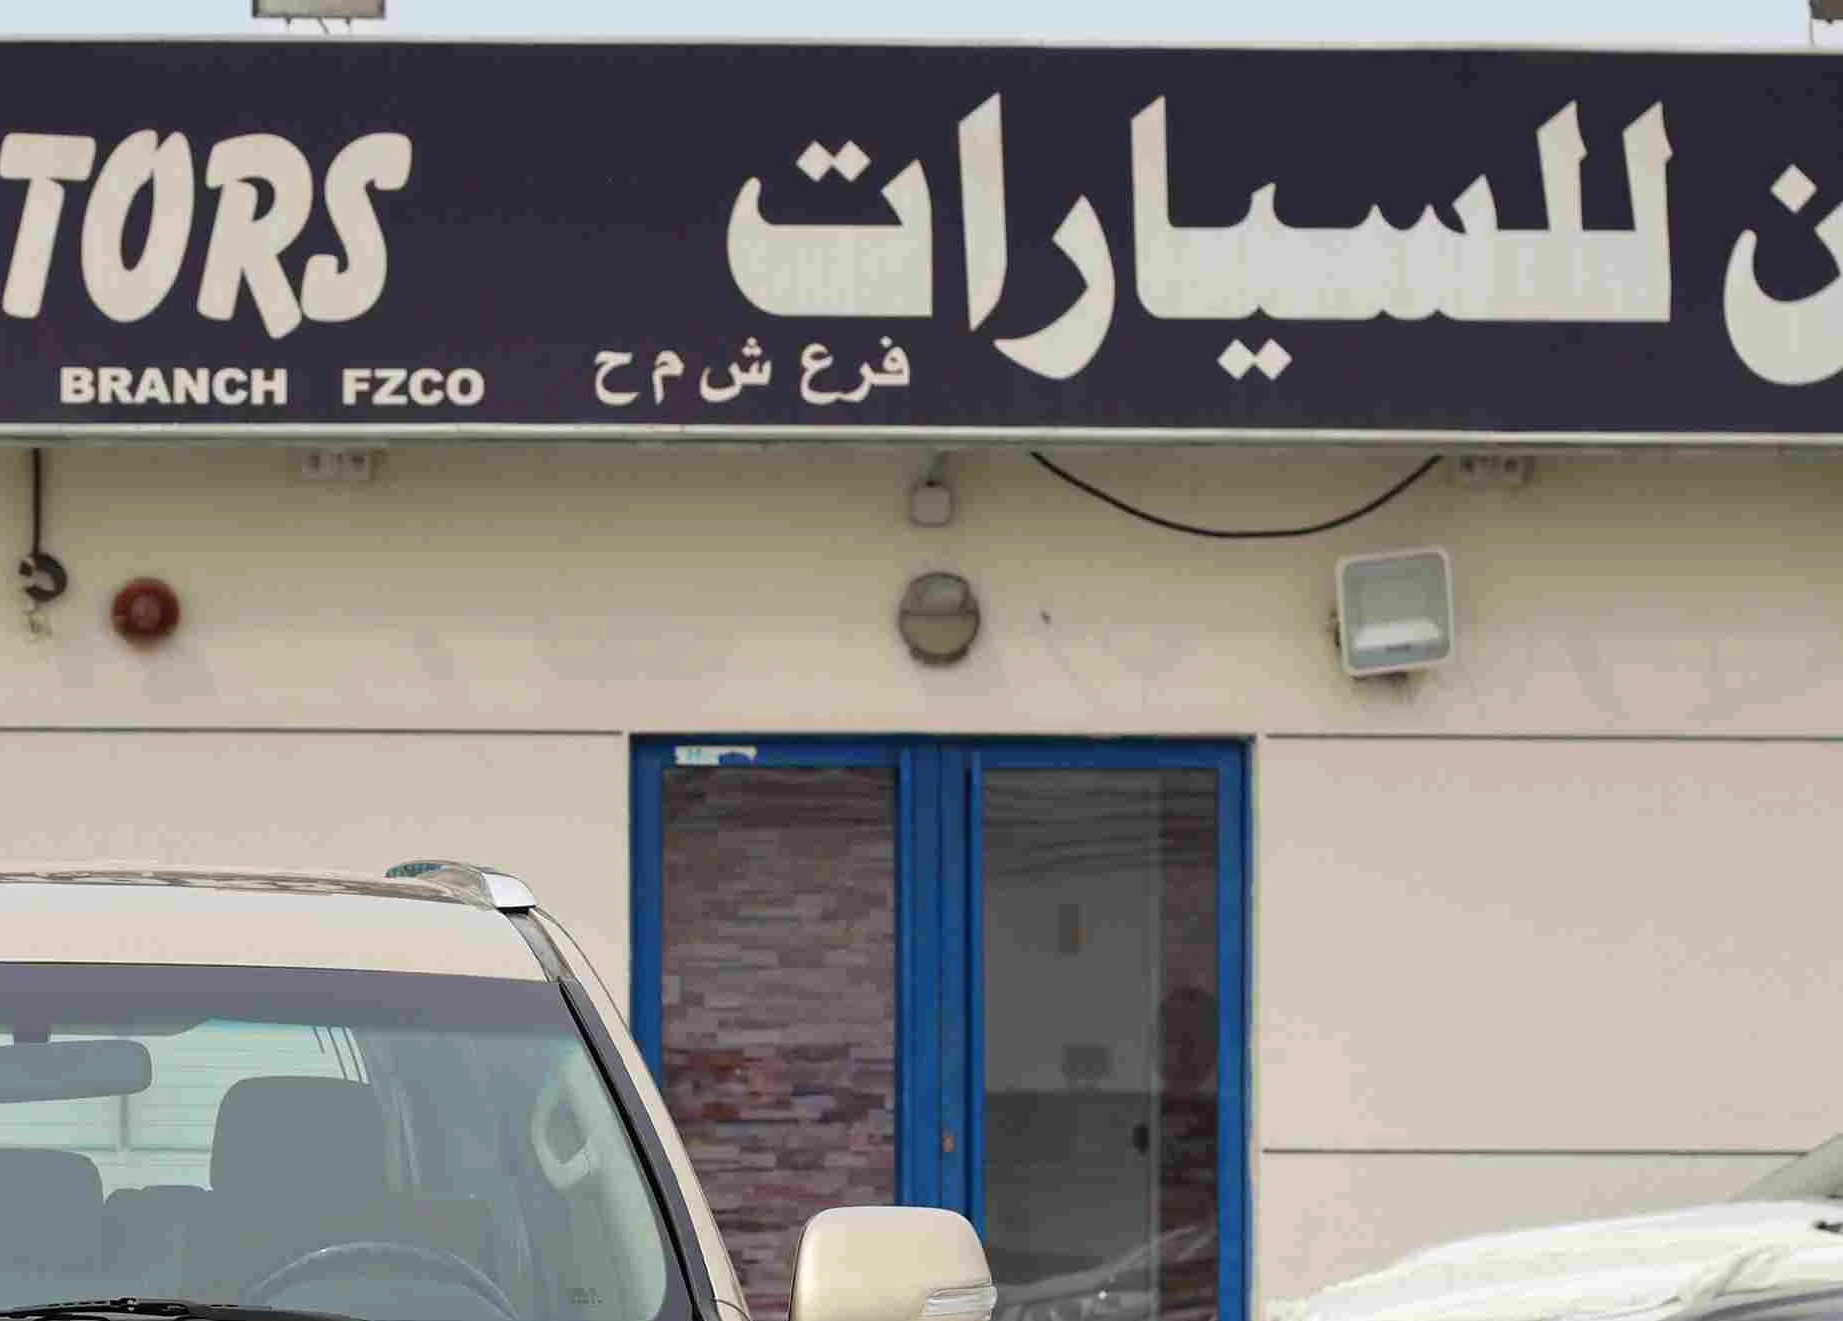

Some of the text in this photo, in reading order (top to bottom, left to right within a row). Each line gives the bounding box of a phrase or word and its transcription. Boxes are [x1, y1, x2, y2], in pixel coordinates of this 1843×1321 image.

[727, 93, 1673, 380] للسيارات
[60, 366, 485, 406] BRANCH FZCO
[594, 335, 911, 406] فرع ش م ح
